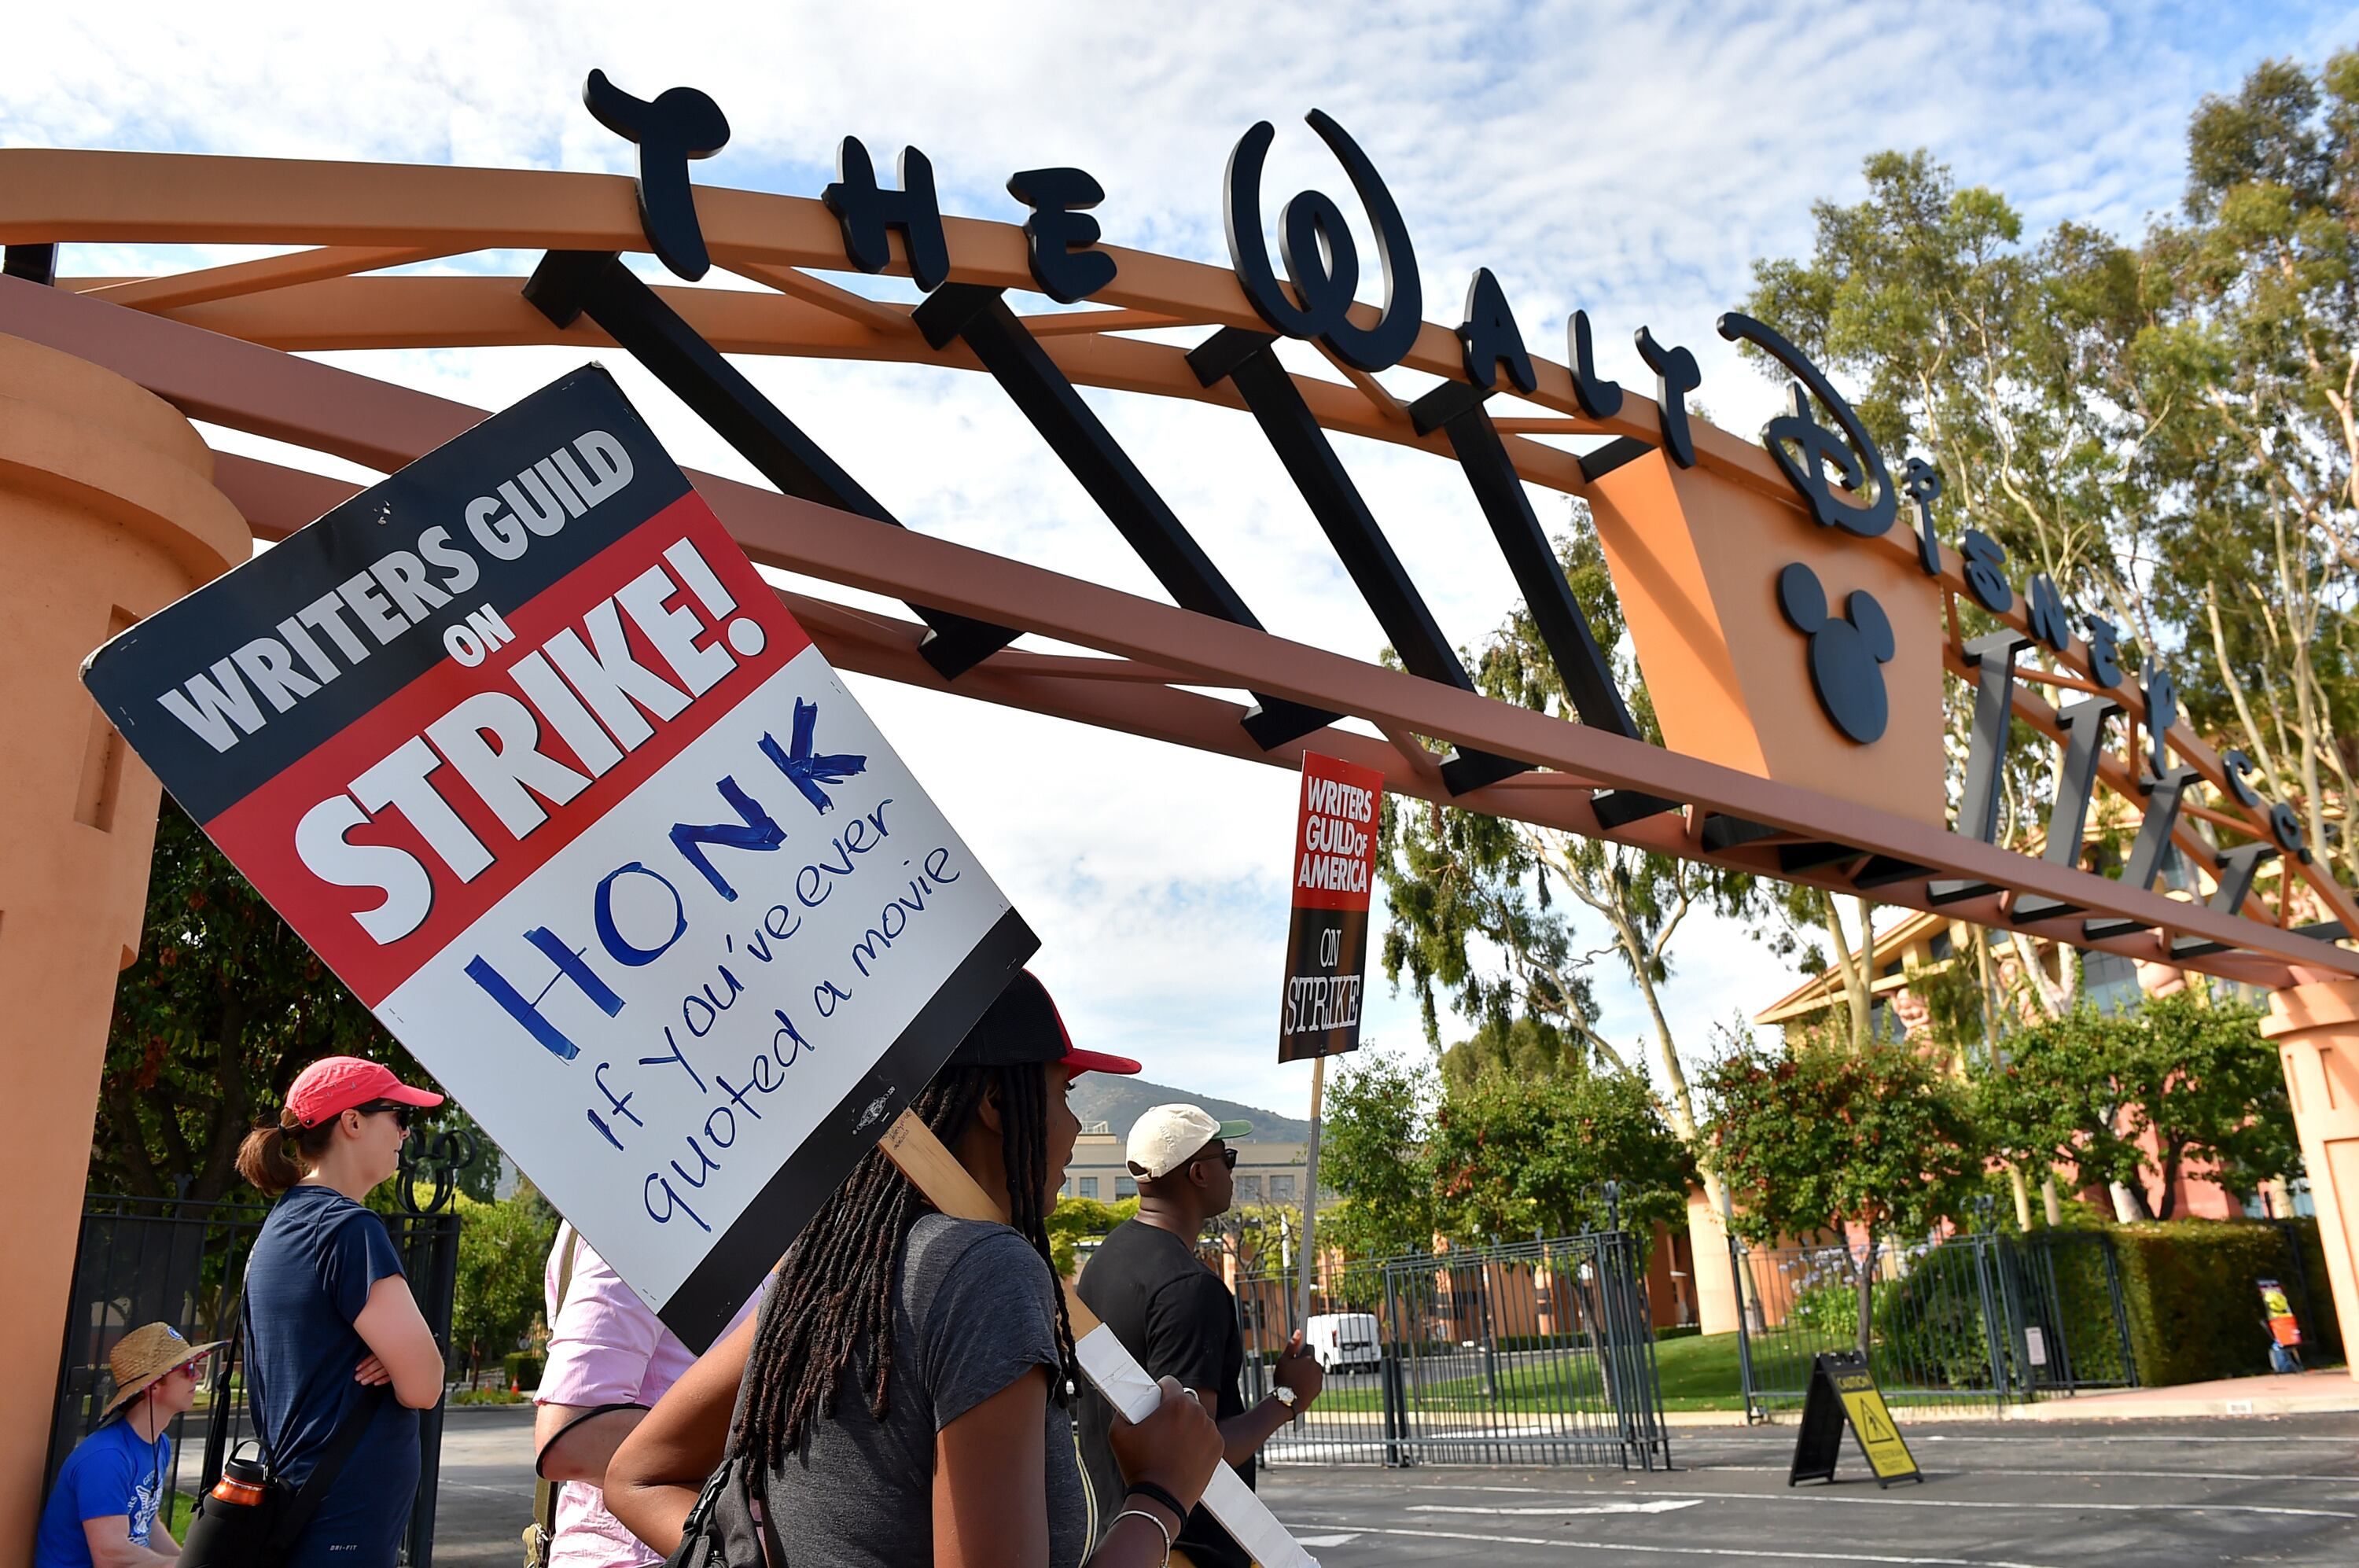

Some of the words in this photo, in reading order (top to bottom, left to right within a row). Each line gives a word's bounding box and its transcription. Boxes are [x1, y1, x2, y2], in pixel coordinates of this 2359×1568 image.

[582, 68, 1117, 304] THE
[1223, 108, 1701, 469] WALT
[158, 525, 480, 754] WRITERS
[465, 429, 635, 561] GUILD
[443, 603, 517, 668] ON
[295, 536, 767, 946] STRIKE!
[1305, 814, 1355, 856] GUILD
[1354, 833, 1367, 857] OF
[1307, 775, 1373, 824] WRITERS
[464, 697, 867, 1062] HONK
[796, 798, 893, 907] ever
[1297, 852, 1367, 893] AMERICA
[1319, 928, 1341, 968] ON
[644, 1009, 815, 1233] quoted
[814, 980, 852, 1018] a
[852, 846, 961, 977] movie
[1284, 974, 1361, 1036] STRIKE
